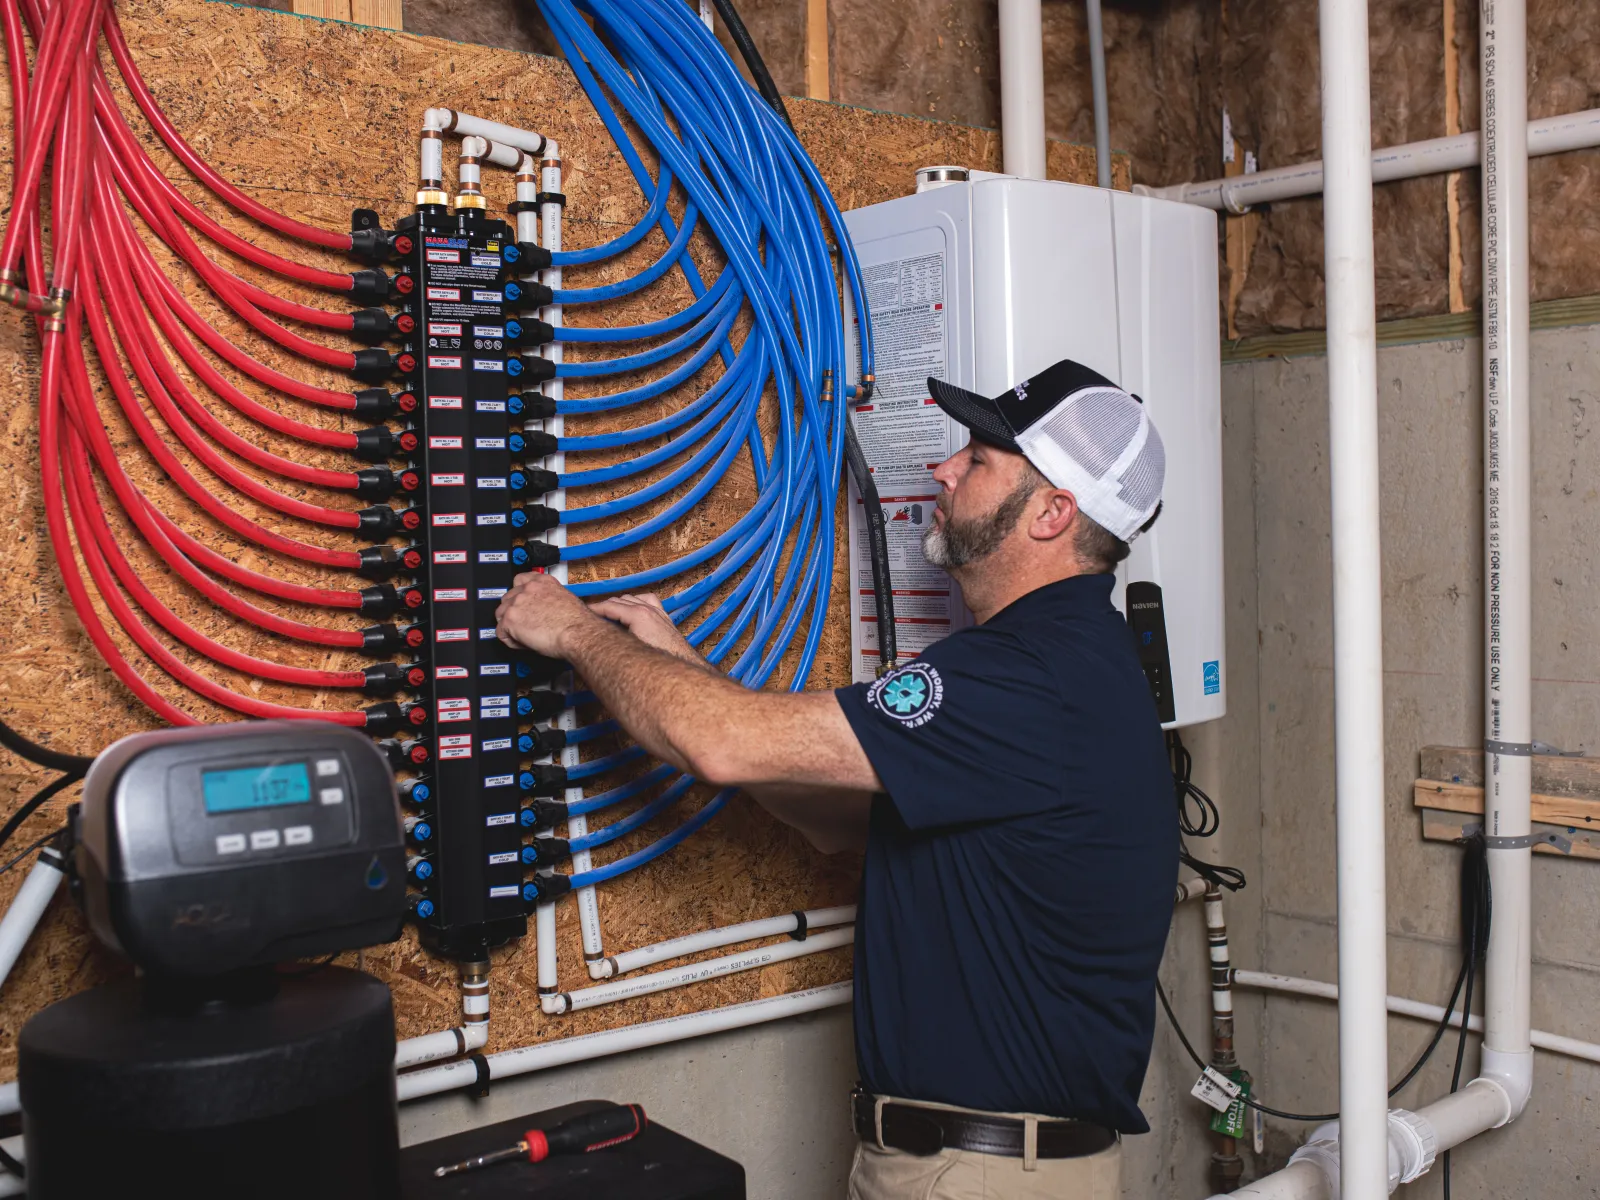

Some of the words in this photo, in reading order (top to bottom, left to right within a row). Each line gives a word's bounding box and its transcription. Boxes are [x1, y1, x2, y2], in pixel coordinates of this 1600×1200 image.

[1485, 60, 1496, 76] SCH
[1486, 78, 1495, 88] 40
[1486, 88, 1496, 118] SERIES
[1486, 119, 1496, 173] COEXTRUDED
[1486, 175, 1497, 215] CELLULAR
[1487, 216, 1497, 239] CORE
[1488, 240, 1498, 256] PVC
[1488, 258, 1498, 276] DWV
[1488, 278, 1498, 296] PIPE
[1488, 298, 1498, 320] ASTM
[1490, 487, 1499, 504] 2016
[1490, 506, 1499, 518] Oct
[1490, 521, 1499, 529] 18
[1490, 533, 1500, 541] 18
[1490, 550, 1500, 570] FOR
[1490, 572, 1500, 592] NON
[1490, 594, 1500, 643] PRESSURE
[1490, 646, 1500, 664] USE
[1490, 666, 1500, 692] ONLY
[682, 972, 698, 982] PLUS
